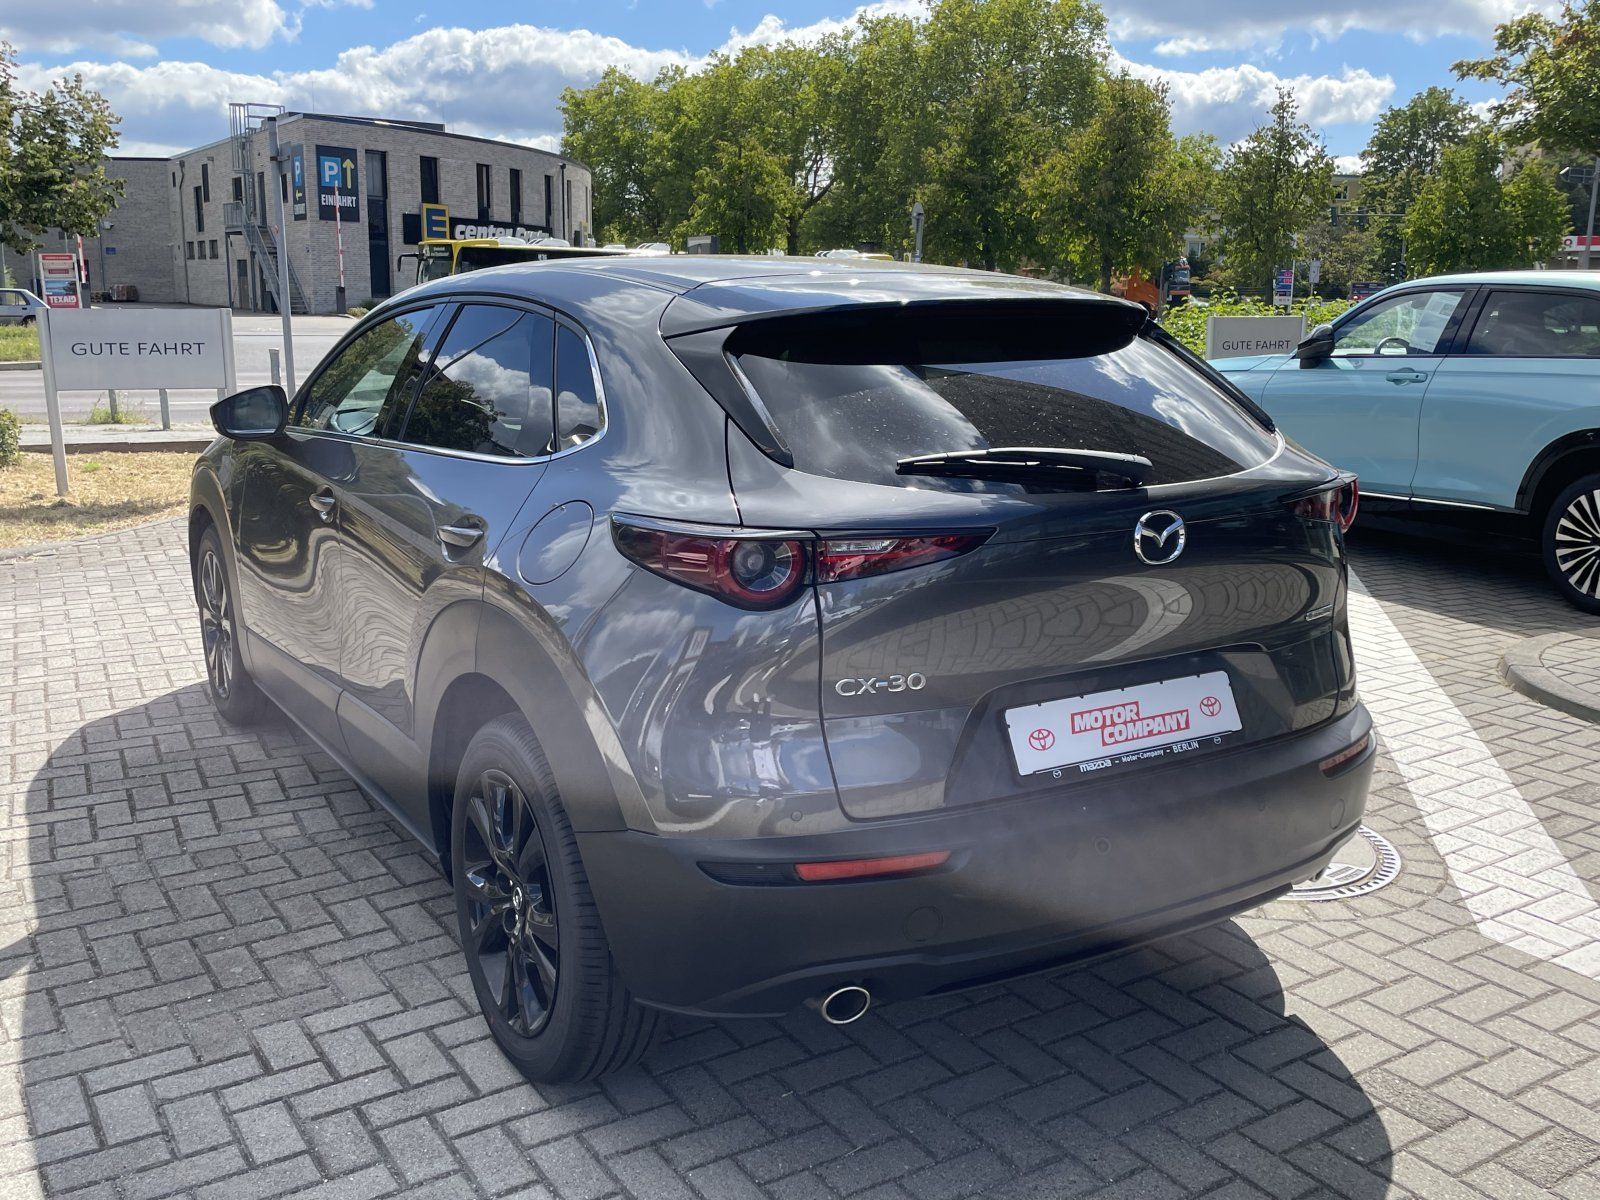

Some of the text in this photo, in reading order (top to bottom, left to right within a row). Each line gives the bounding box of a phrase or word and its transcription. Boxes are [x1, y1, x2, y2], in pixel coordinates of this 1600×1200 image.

[324, 161, 339, 182] P
[425, 207, 447, 239] E
[454, 224, 514, 240] center
[71, 342, 206, 356] GUTE FAHRT
[1222, 340, 1291, 351] GUTE FAHRT
[835, 672, 927, 696] CX-30
[1074, 704, 1138, 731] MOTOR
[1104, 712, 1188, 744] COMPANY
[1173, 741, 1199, 754] BERLIN
